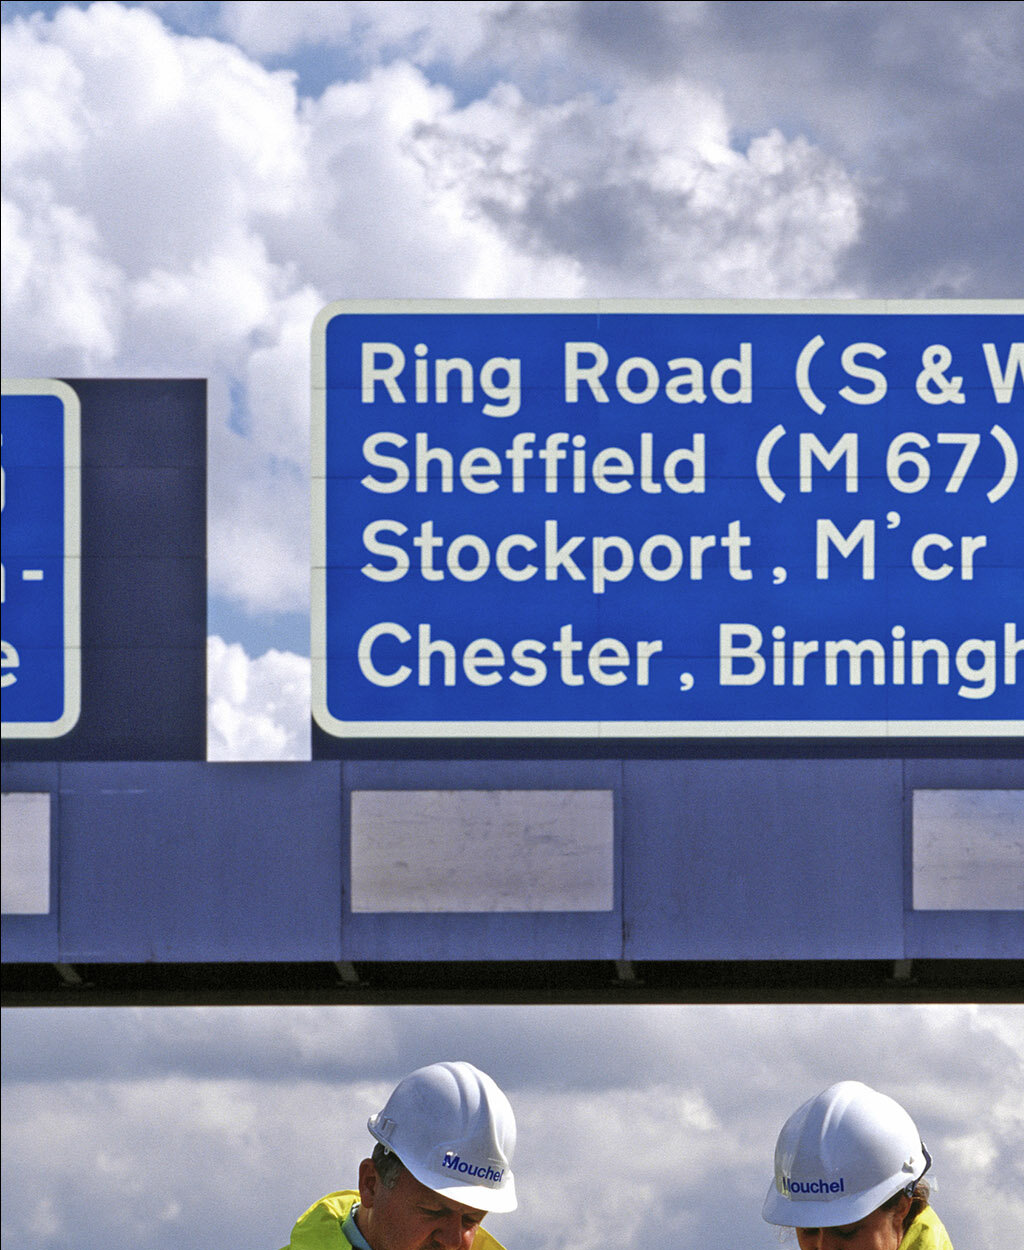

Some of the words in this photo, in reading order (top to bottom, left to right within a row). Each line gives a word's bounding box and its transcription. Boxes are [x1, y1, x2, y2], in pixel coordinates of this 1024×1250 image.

[361, 342, 521, 418] Ring
[564, 341, 753, 405] Road
[795, 335, 888, 415] (S
[915, 344, 966, 405] &
[361, 432, 706, 494] Sheffield
[756, 424, 859, 504] (M
[886, 424, 1019, 504] 67)
[360, 519, 787, 594] Stockport,
[357, 622, 694, 691] Chester,
[442, 1154, 504, 1182] Mouchel
